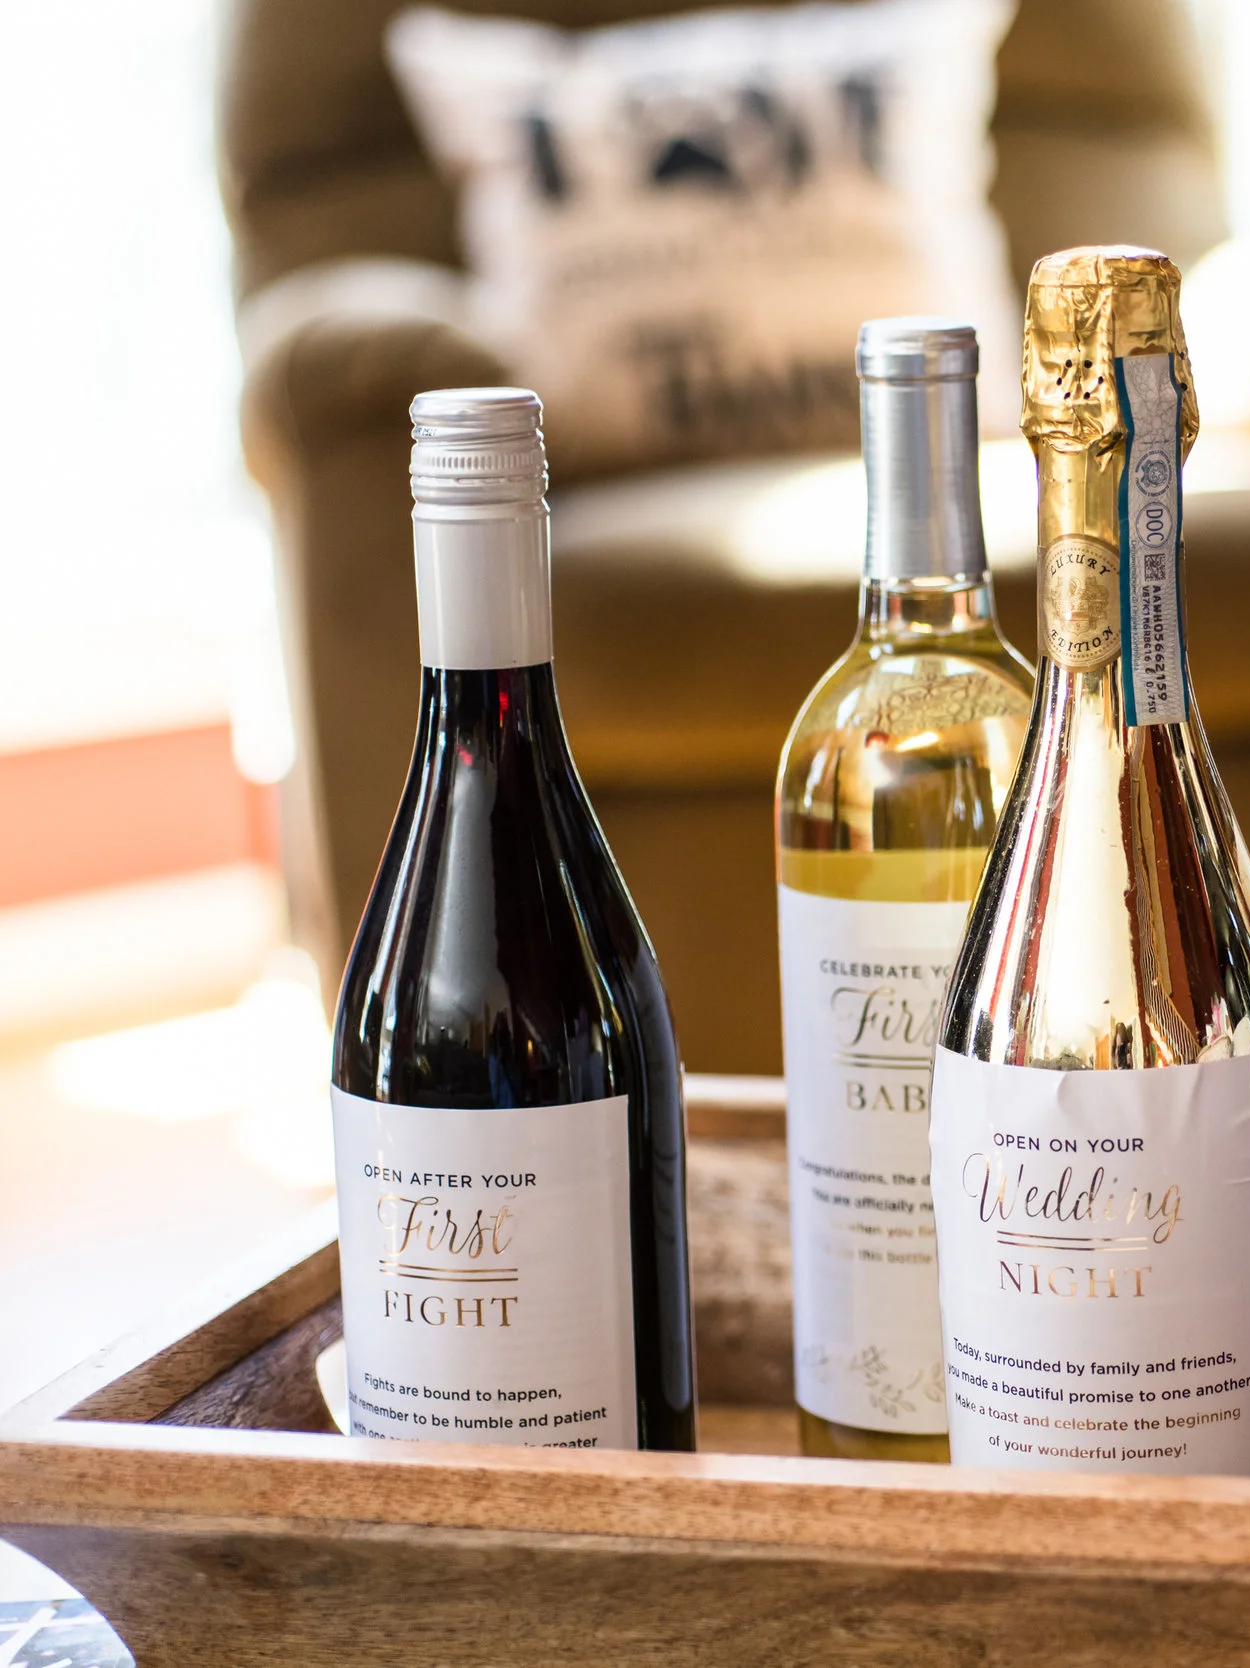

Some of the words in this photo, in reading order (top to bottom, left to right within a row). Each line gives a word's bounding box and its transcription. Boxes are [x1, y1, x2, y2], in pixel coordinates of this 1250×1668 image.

[1145, 508, 1165, 542] DOC
[1050, 553, 1111, 576] LUXURY
[1051, 626, 1114, 653] EDITION
[820, 958, 922, 979] CELEBRATE
[931, 965, 951, 978] YO
[830, 985, 939, 1048] Firs
[845, 1080, 927, 1113] BAB
[993, 1132, 1040, 1151] OPEN
[1050, 1139, 1077, 1153] ON
[1087, 1138, 1144, 1153] YOUR
[364, 1164, 402, 1183] OPEN
[410, 1172, 472, 1188] AFTER
[482, 1173, 536, 1188] YOUR
[962, 1152, 1185, 1244] Wedding
[377, 1194, 516, 1259] First
[999, 1260, 1152, 1298] NIGHT
[383, 1290, 518, 1327] FIGHT
[953, 1337, 982, 1361] Today,
[985, 1351, 1061, 1373] surrounded
[1066, 1361, 1085, 1377] by
[1090, 1362, 1140, 1377] family
[1145, 1359, 1176, 1374] and
[1180, 1350, 1237, 1371] friends,
[364, 1373, 395, 1393] Fights
[398, 1384, 418, 1397] are
[423, 1386, 470, 1401] bound
[476, 1390, 492, 1401] to
[498, 1387, 562, 1404] happen,
[961, 1371, 988, 1389] made
[1002, 1381, 1064, 1402] beautiful
[1069, 1391, 1134, 1405] promise
[1139, 1389, 1156, 1402] to
[1161, 1387, 1191, 1401] one
[358, 1398, 409, 1422] remember
[413, 1412, 427, 1425] to
[431, 1414, 450, 1427] be
[454, 1416, 513, 1429] humble
[518, 1414, 548, 1427] and
[553, 1407, 607, 1427] patient
[954, 1392, 977, 1413] Make
[988, 1406, 1019, 1424] toast
[1023, 1414, 1050, 1428] and
[1054, 1417, 1128, 1432] celebrate
[1133, 1416, 1160, 1431] the
[1165, 1407, 1242, 1430] beginning
[1003, 1438, 1034, 1453] your
[1037, 1444, 1117, 1460] wonderful
[1120, 1443, 1188, 1461] journey!
